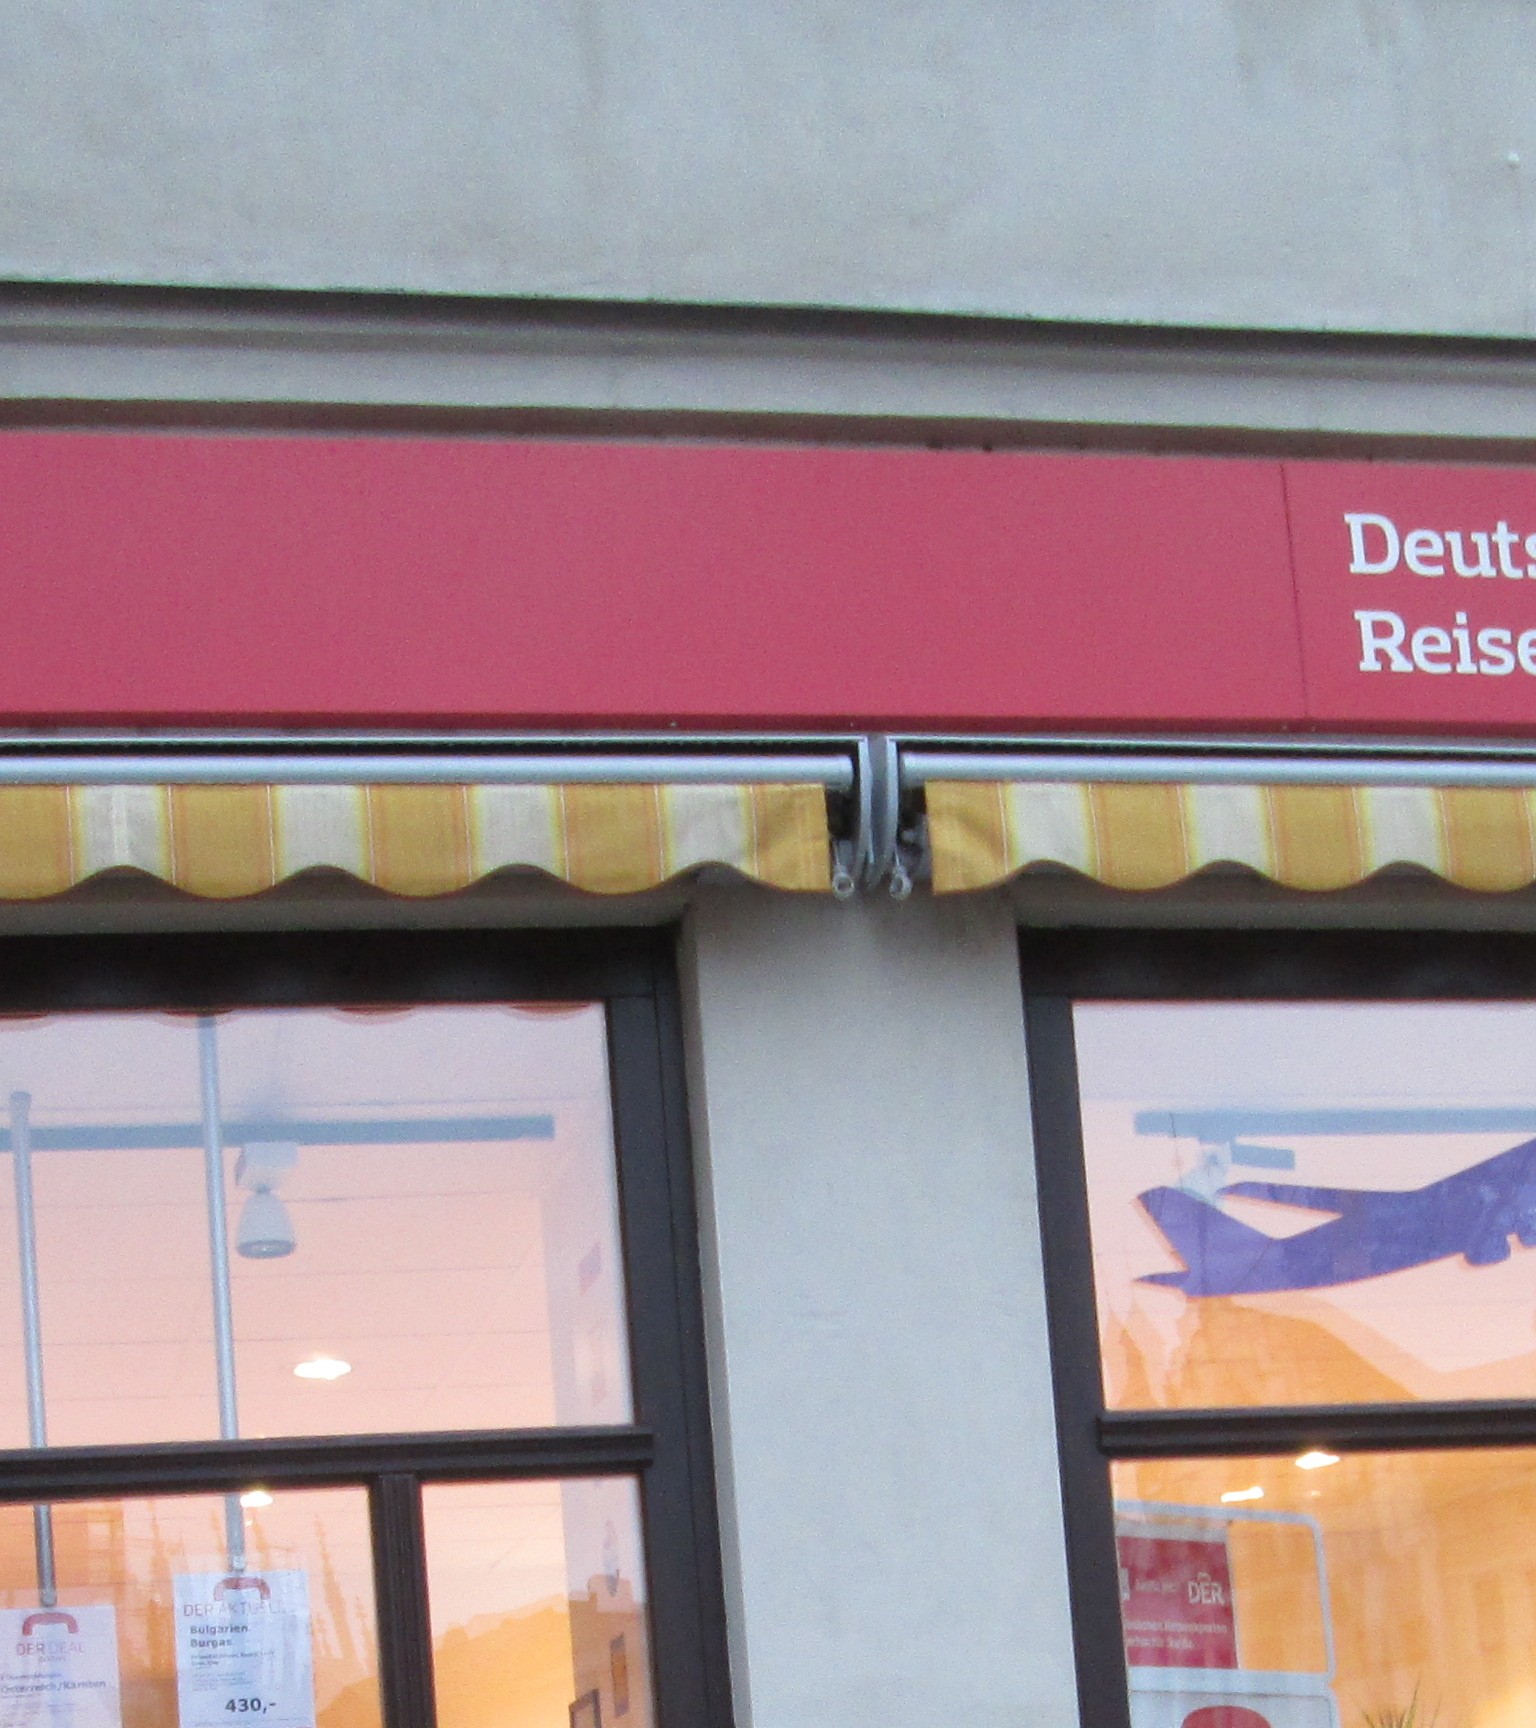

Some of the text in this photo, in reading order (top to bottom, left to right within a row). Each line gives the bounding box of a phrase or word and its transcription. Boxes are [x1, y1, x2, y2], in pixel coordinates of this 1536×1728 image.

[1187, 1581, 1226, 1605] DER
[189, 1623, 249, 1636] Bulgarien
[224, 1697, 277, 1714] 430,-
